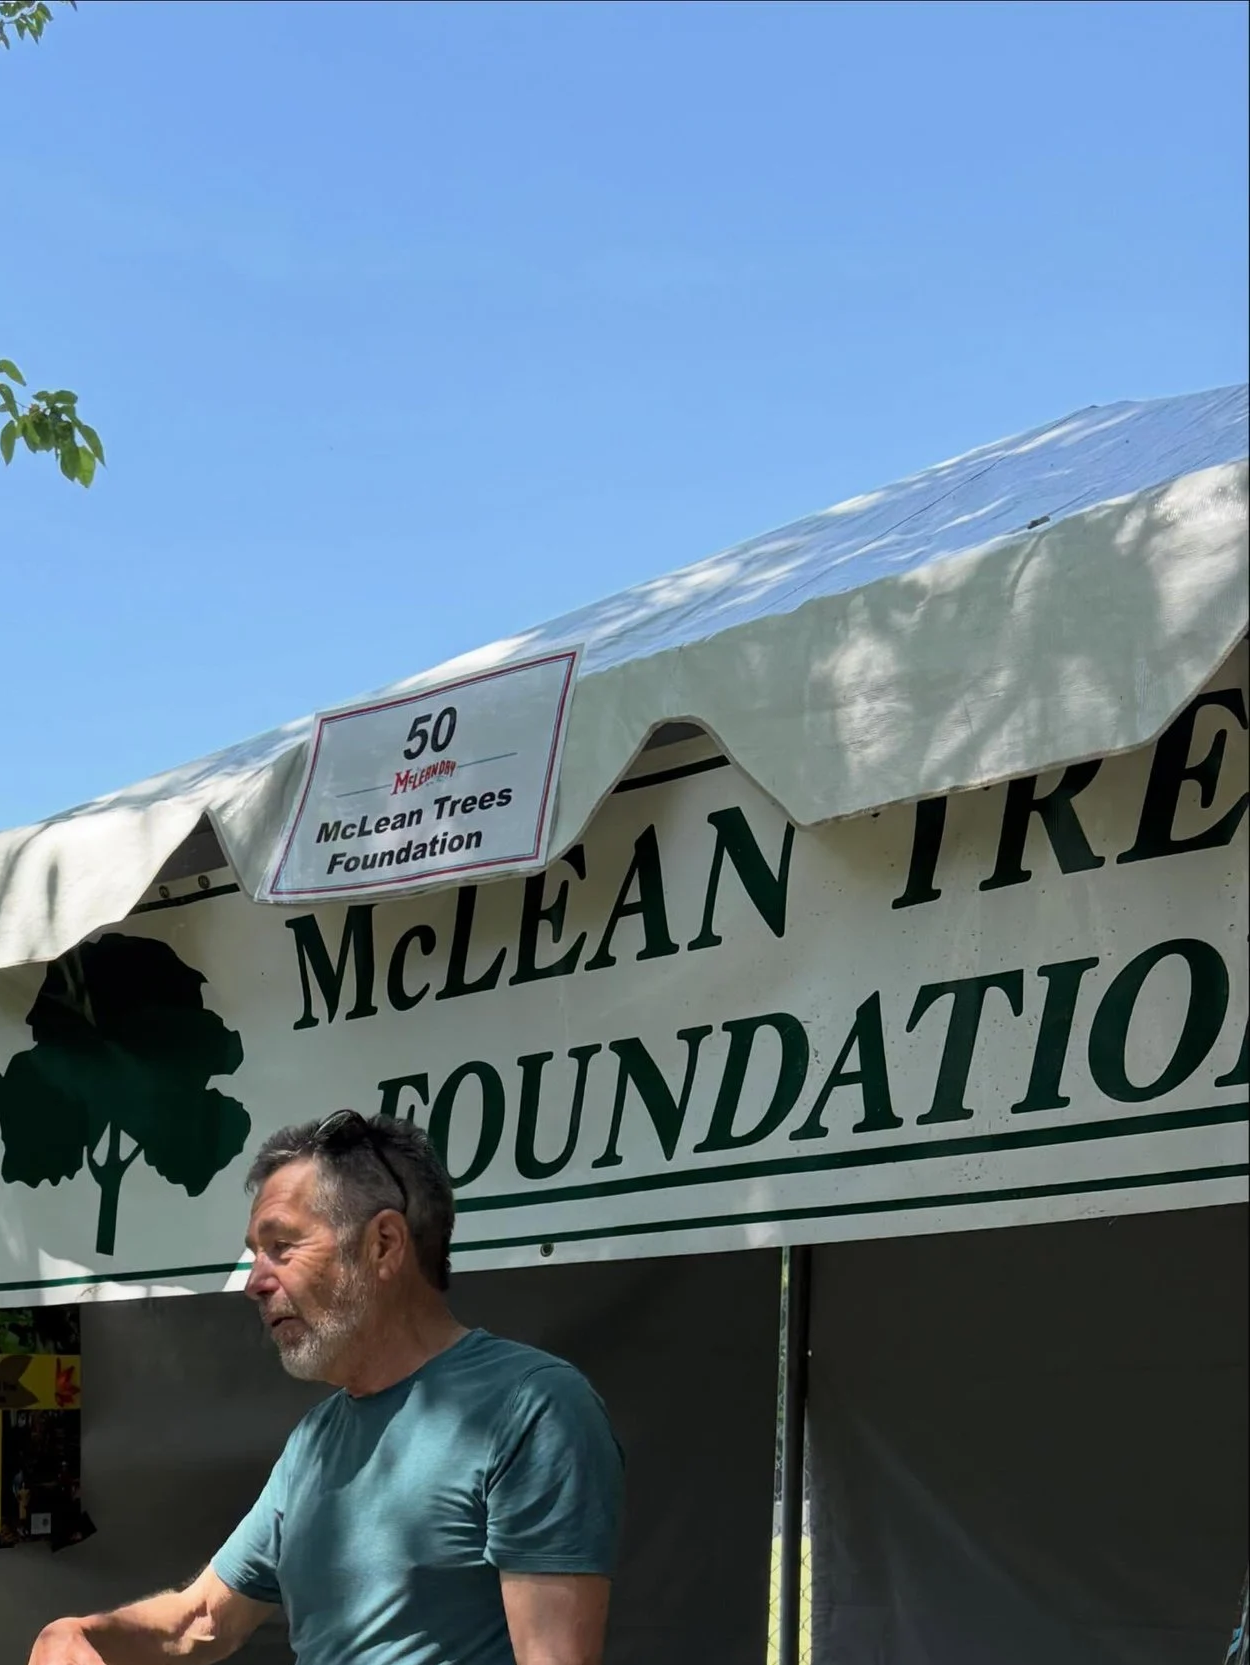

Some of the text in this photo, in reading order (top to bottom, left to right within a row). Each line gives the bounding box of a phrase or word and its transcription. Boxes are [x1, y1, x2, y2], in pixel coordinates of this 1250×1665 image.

[403, 706, 457, 761] 50
[315, 786, 513, 844] McLean Trees
[326, 830, 483, 875] Foundation
[285, 805, 796, 1031] McLEAN
[377, 937, 1249, 1190] FOUNDATIO
